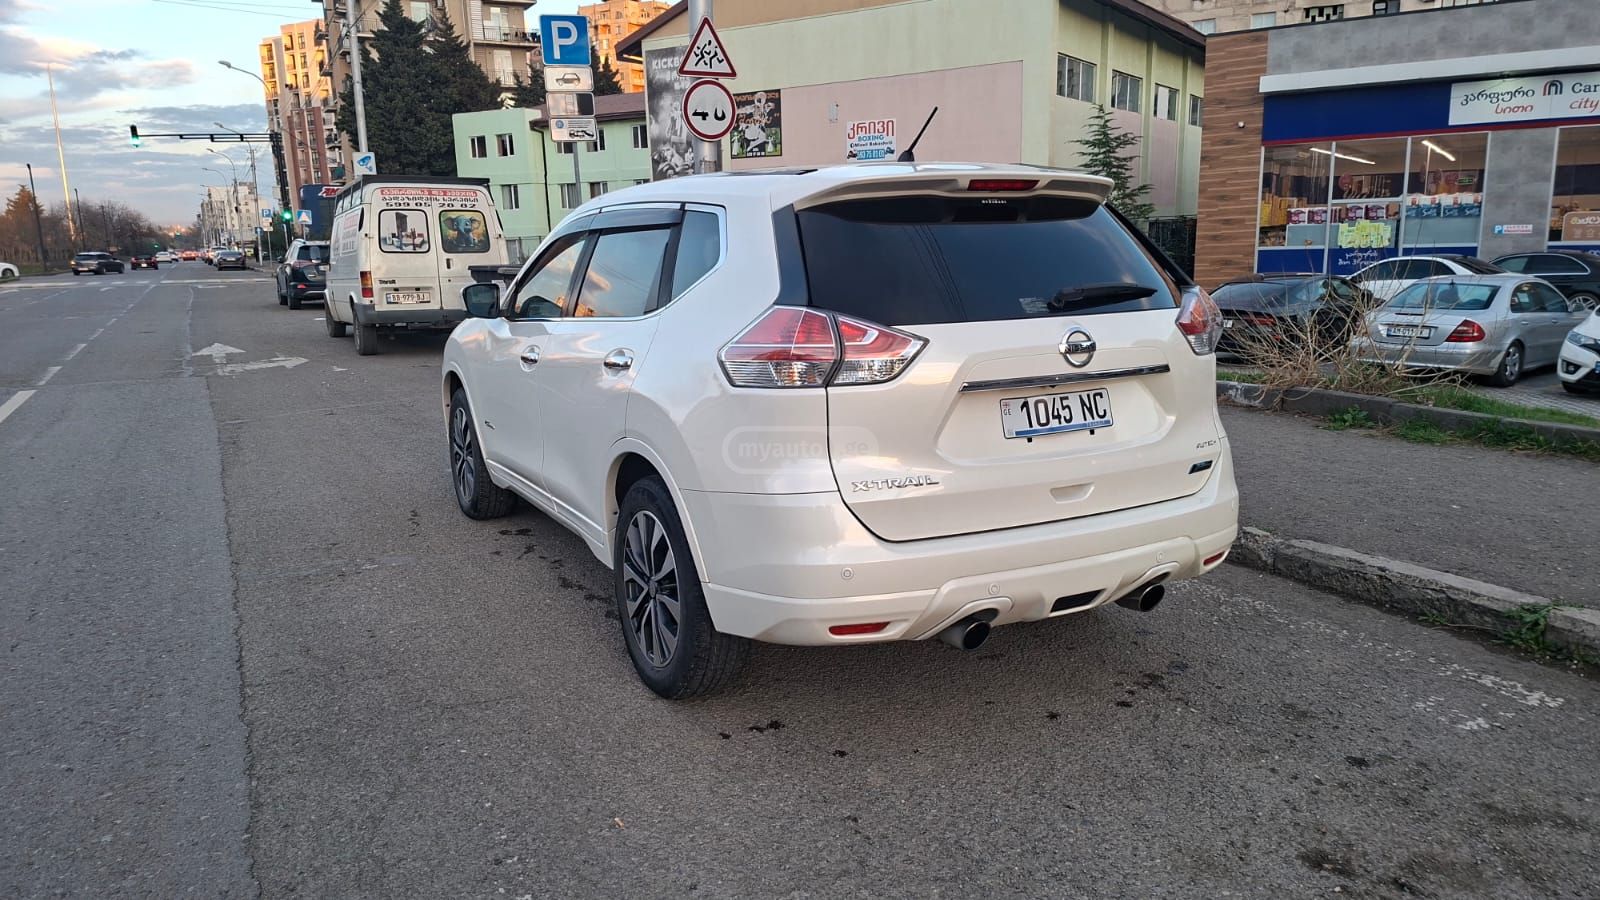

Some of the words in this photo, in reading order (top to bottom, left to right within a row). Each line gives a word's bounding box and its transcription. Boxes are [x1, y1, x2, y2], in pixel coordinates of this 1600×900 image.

[551, 21, 578, 59] P
[652, 56, 682, 69] KICKB
[1460, 86, 1535, 106] კარფური
[1495, 103, 1534, 114] სითი
[1569, 97, 1600, 113] city
[847, 120, 894, 139] კრივი
[858, 134, 884, 142] BOXING
[1020, 396, 1073, 428] 1045
[1079, 392, 1107, 422] NC
